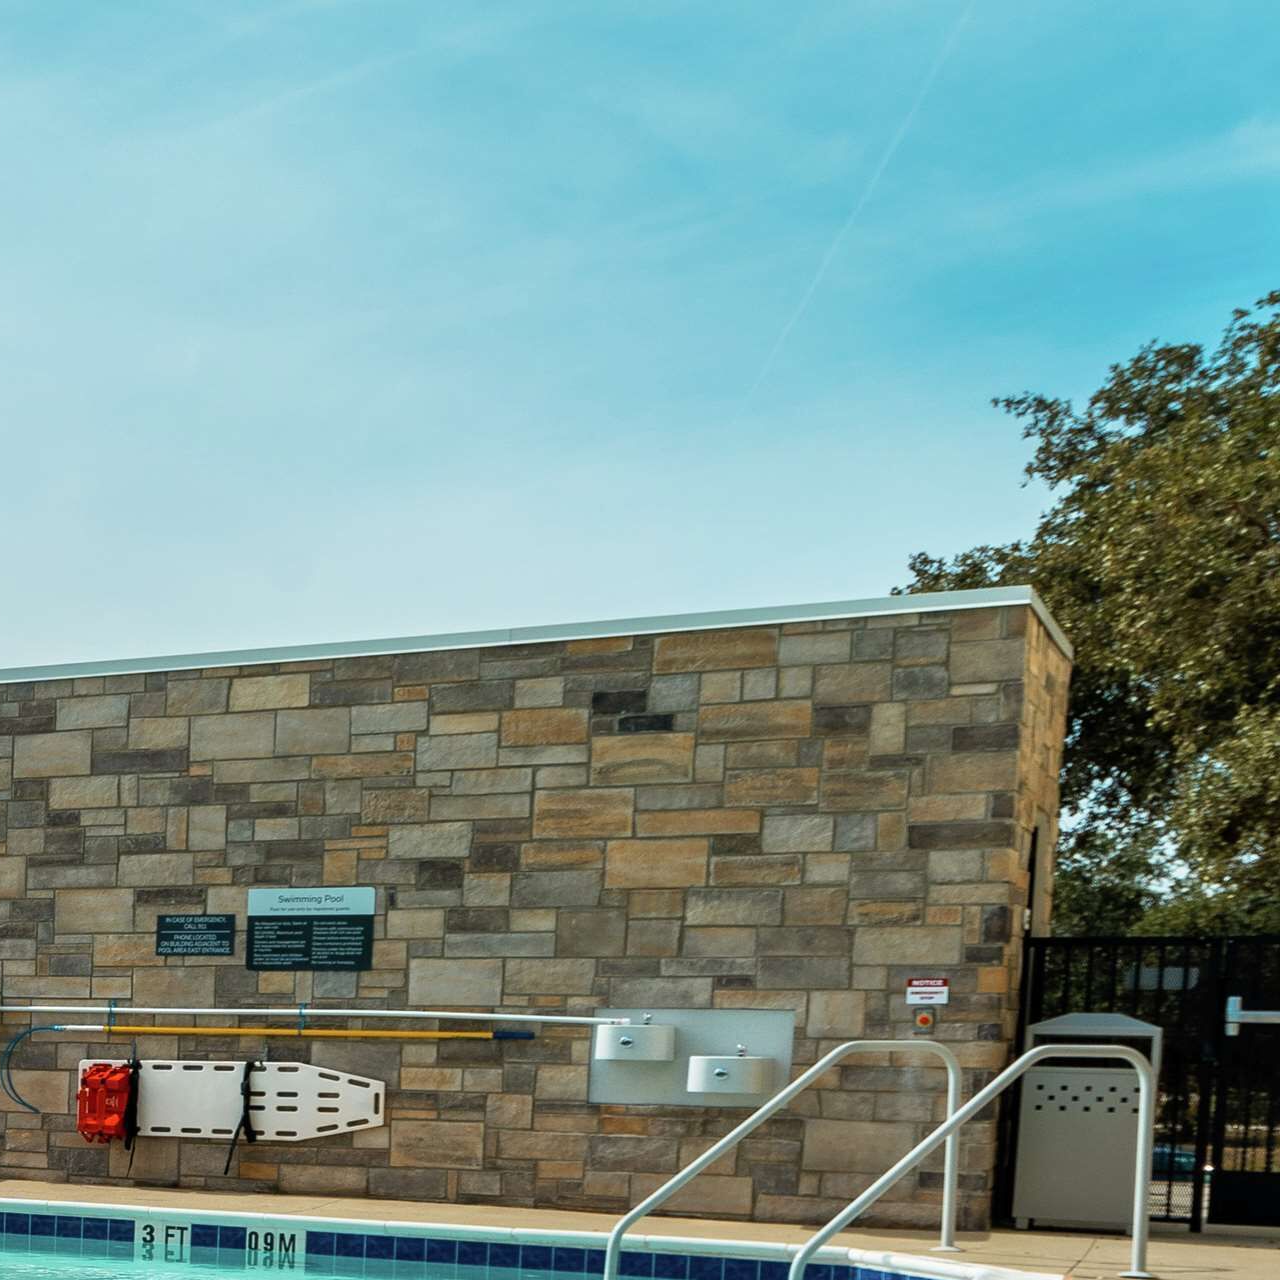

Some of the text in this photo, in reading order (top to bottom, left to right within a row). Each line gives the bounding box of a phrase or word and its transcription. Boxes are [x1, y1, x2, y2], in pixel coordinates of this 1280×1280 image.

[324, 894, 345, 903] Pool
[142, 1224, 188, 1245] 3 FT
